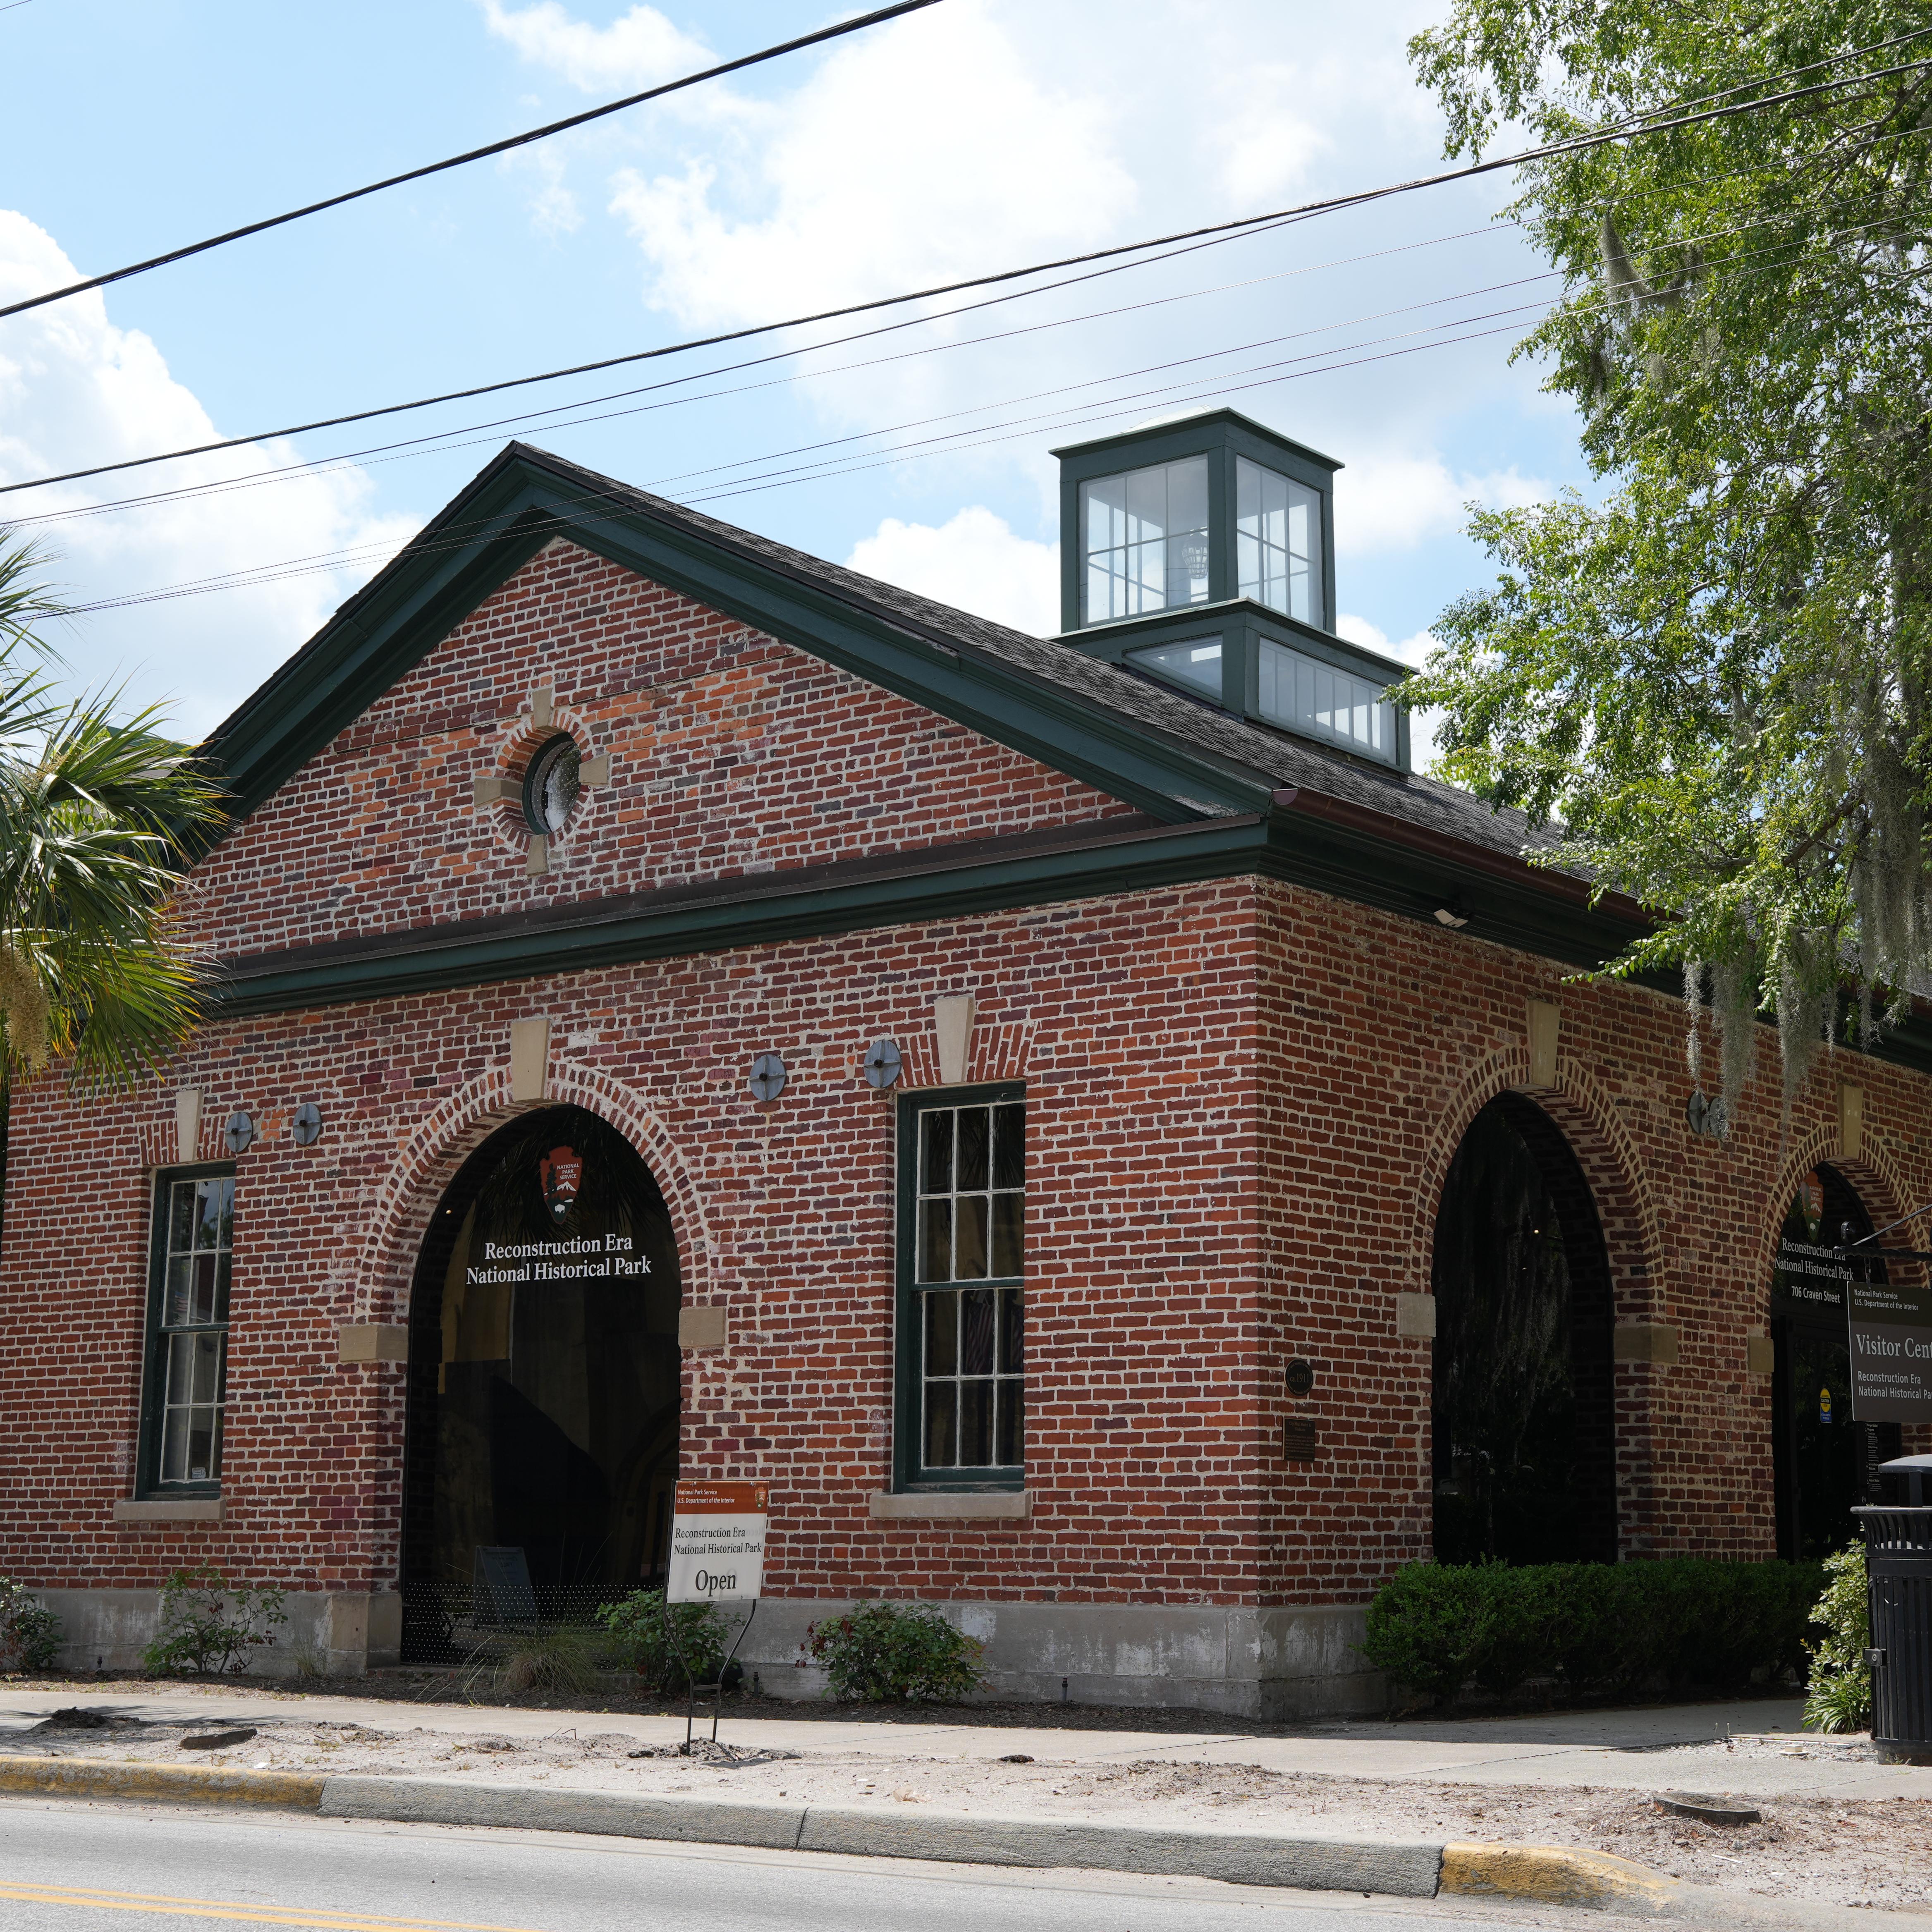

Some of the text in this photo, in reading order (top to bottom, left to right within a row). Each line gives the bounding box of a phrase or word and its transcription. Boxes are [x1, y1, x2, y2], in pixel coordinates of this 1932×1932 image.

[485, 1234, 633, 1260] Reconstruction Era
[1782, 1237, 1833, 1258] Reconstruction
[466, 1255, 652, 1284] National Historical Park
[1774, 1256, 1854, 1281] National Historical Park
[1791, 1286, 1841, 1303] 706 Craven Street
[1864, 1299, 1889, 1308] Department
[1855, 1334, 1901, 1356] Visitor
[1858, 1370, 1921, 1384] Reconstruction Era
[1858, 1386, 1887, 1397] National
[1890, 1387, 1921, 1399] Historical
[675, 1528, 731, 1538] Reconstruction
[733, 1527, 746, 1537] Era
[674, 1542, 762, 1554] National Historical Park
[696, 1570, 736, 1597] Open
